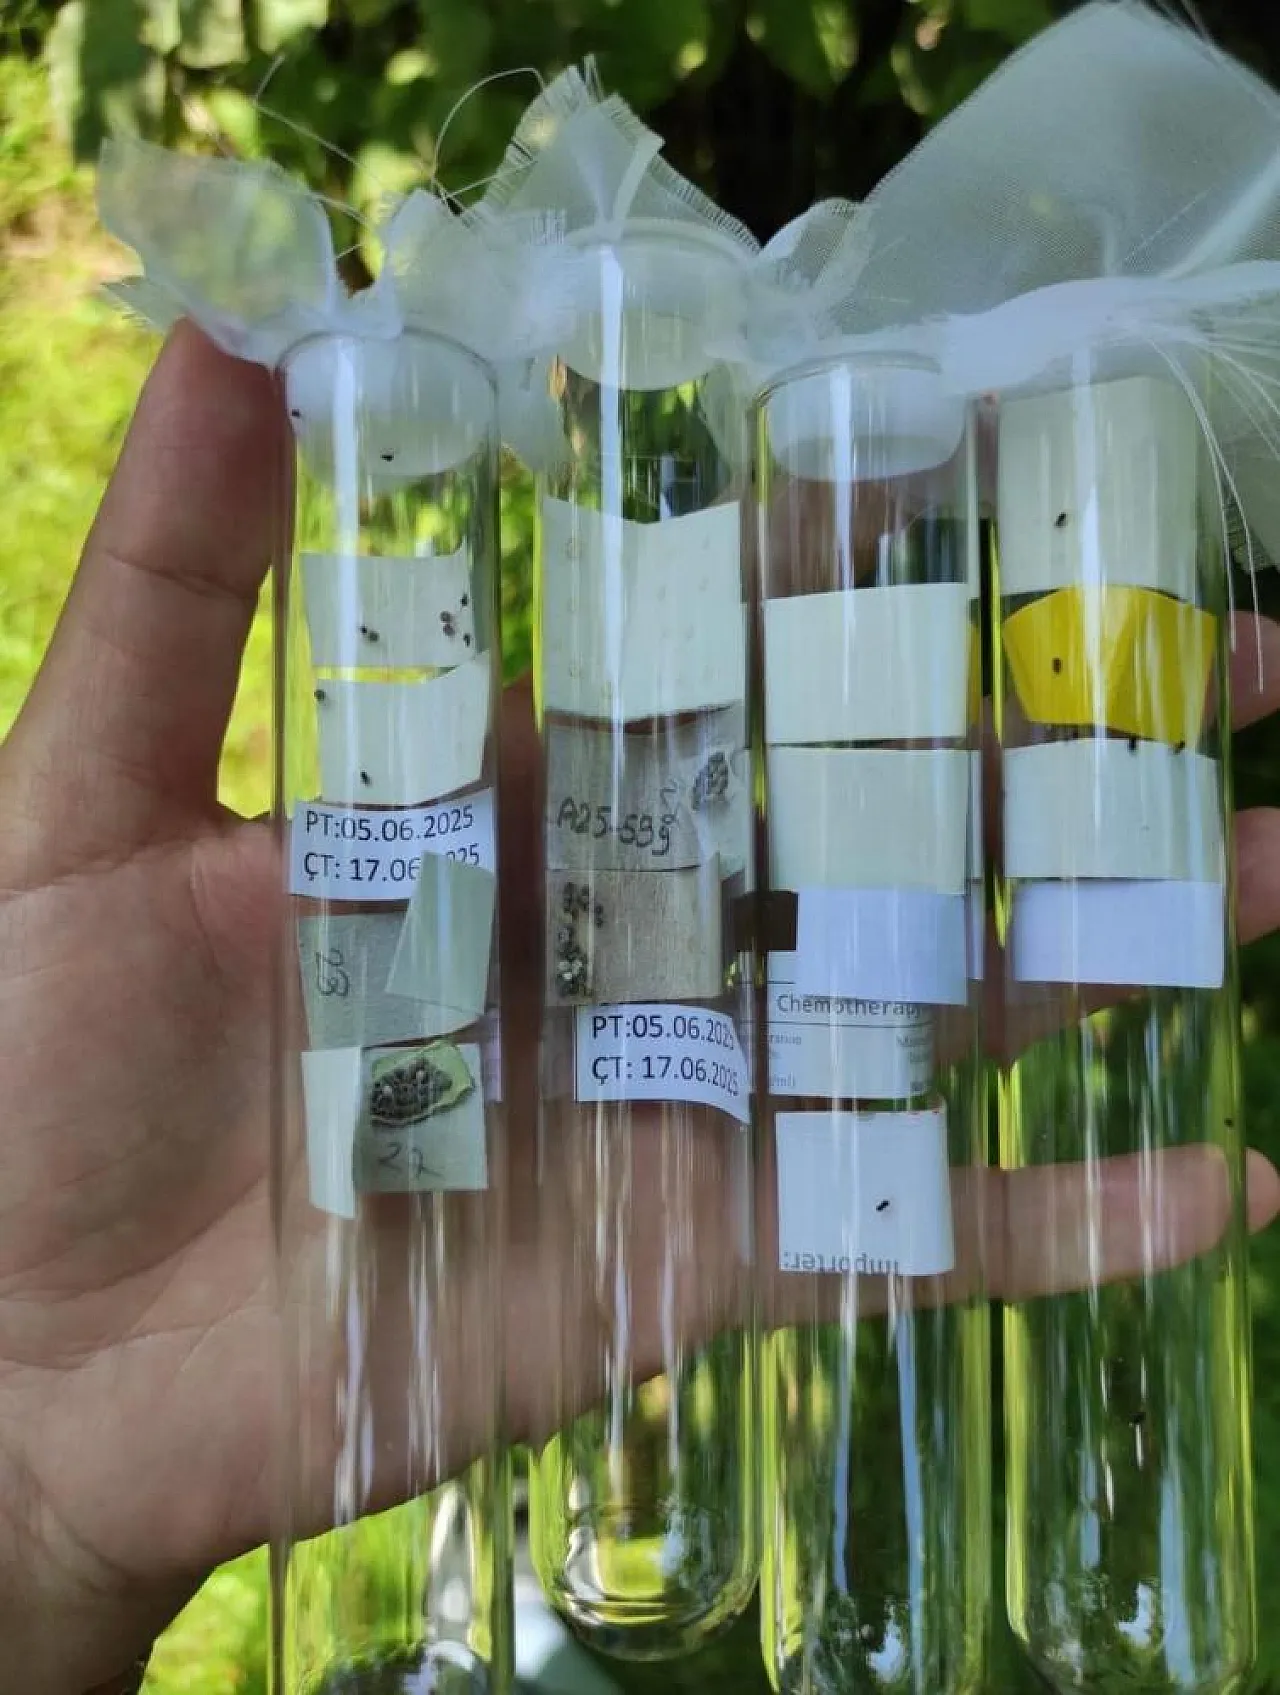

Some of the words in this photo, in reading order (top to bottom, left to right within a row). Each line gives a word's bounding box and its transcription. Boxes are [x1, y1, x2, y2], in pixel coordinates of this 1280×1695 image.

[305, 803, 474, 843] PT:05.06.2025
[303, 851, 341, 881] ÇT:
[592, 1056, 633, 1085] ÇT:
[642, 1056, 739, 1096] 17.06.2025
